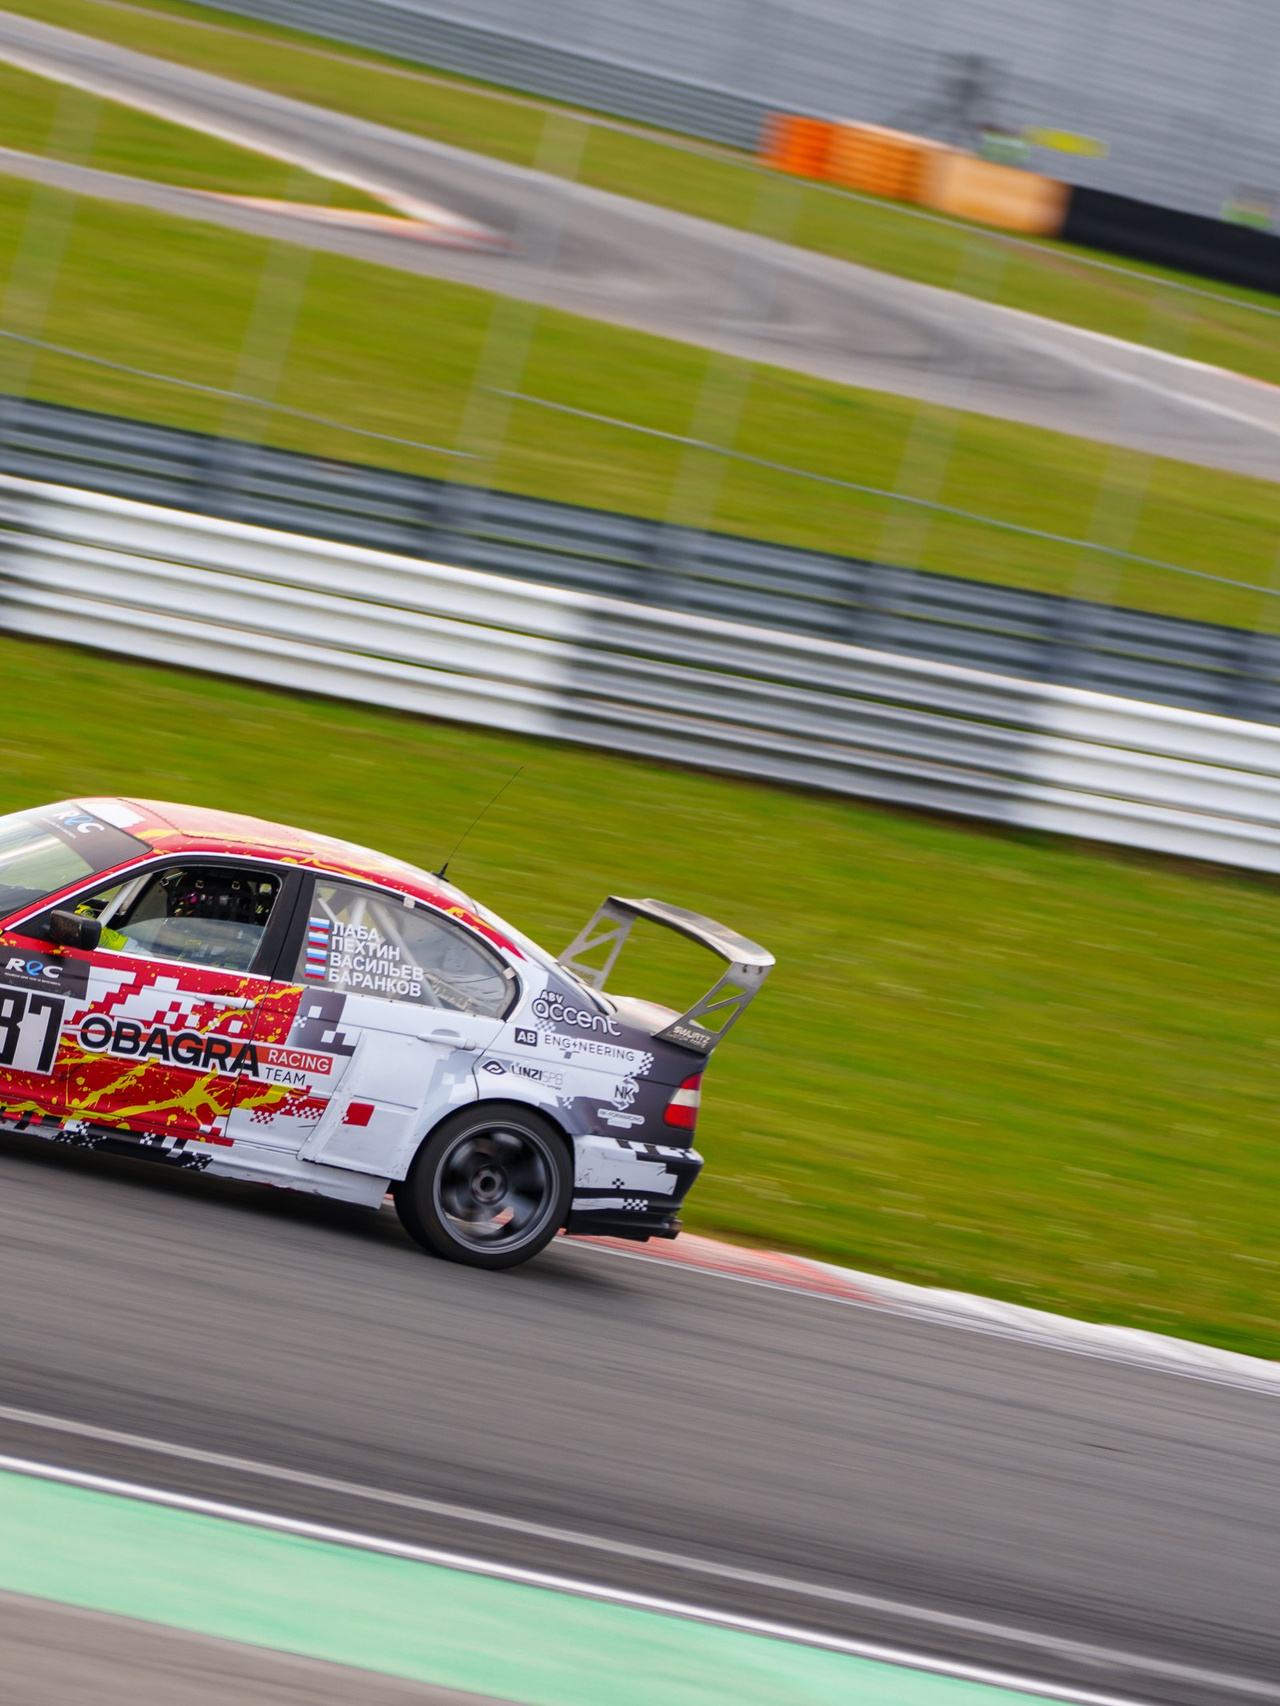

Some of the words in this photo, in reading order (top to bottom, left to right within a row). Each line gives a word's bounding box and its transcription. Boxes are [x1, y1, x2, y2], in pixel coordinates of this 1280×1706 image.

[332, 921, 379, 942] ЛАБА
[331, 936, 400, 961] ПЕХТИН
[330, 952, 424, 981] ВАСИЛЬЕВ
[328, 968, 422, 997] БАРАНКОВ
[540, 990, 564, 1004] ABV
[532, 998, 622, 1036] accent
[80, 1016, 260, 1078] OBAGRA
[517, 1030, 536, 1044] AB
[267, 1049, 330, 1073] RACING
[265, 1066, 307, 1086] TEAM
[614, 1084, 633, 1101] NK
